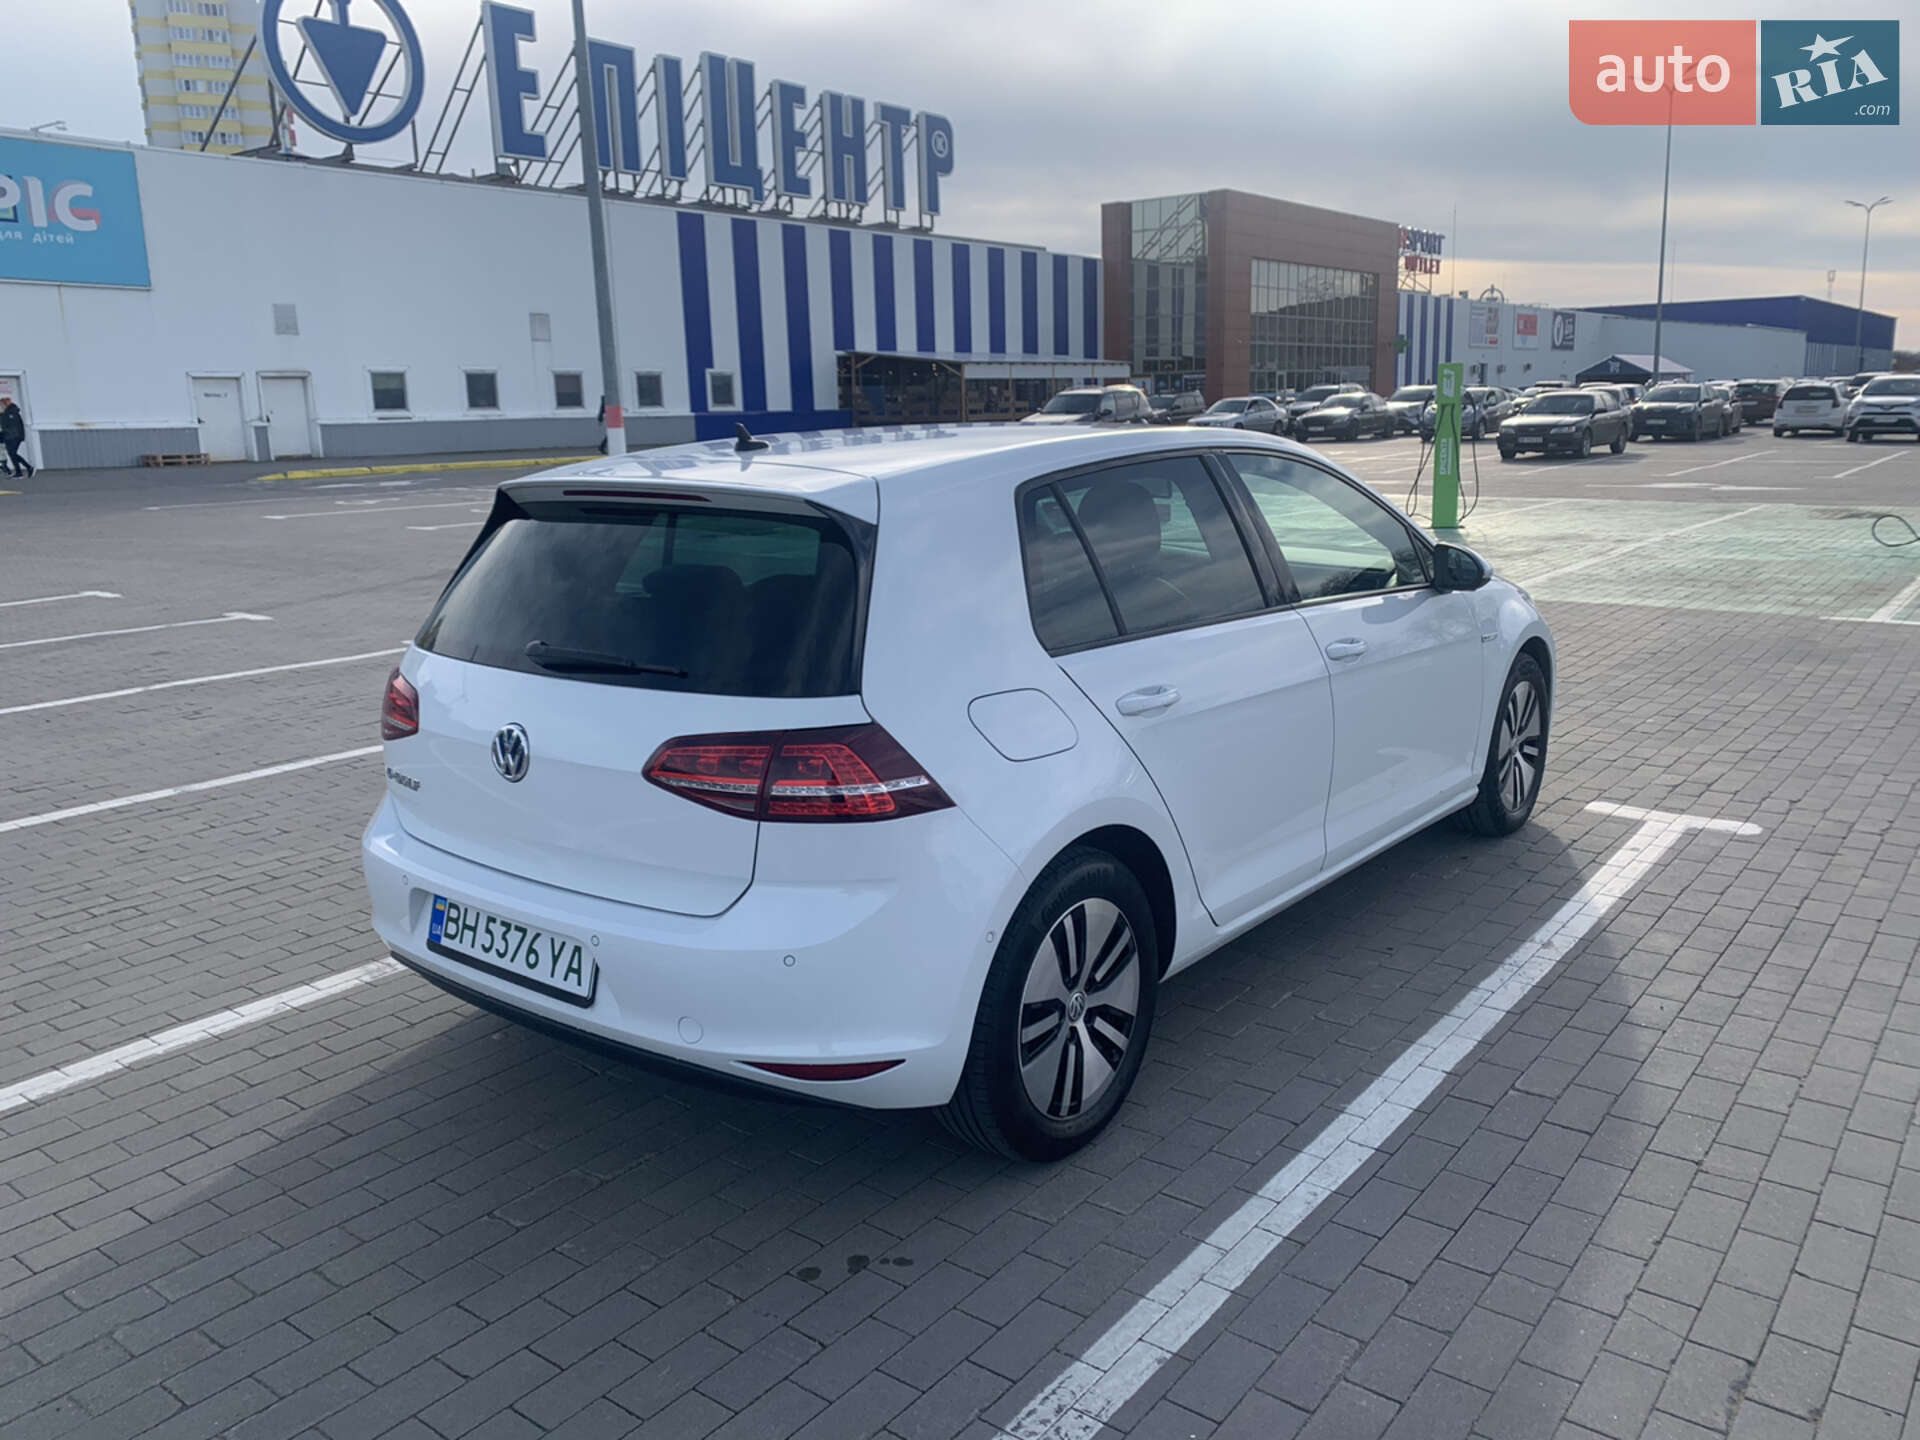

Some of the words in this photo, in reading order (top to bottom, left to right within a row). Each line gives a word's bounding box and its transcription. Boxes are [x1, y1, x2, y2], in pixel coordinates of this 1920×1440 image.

[482, 0, 954, 216] ЕПІЦЕНТР
[443, 902, 480, 949] BH
[481, 916, 542, 970] 5376
[550, 937, 583, 987] YA
